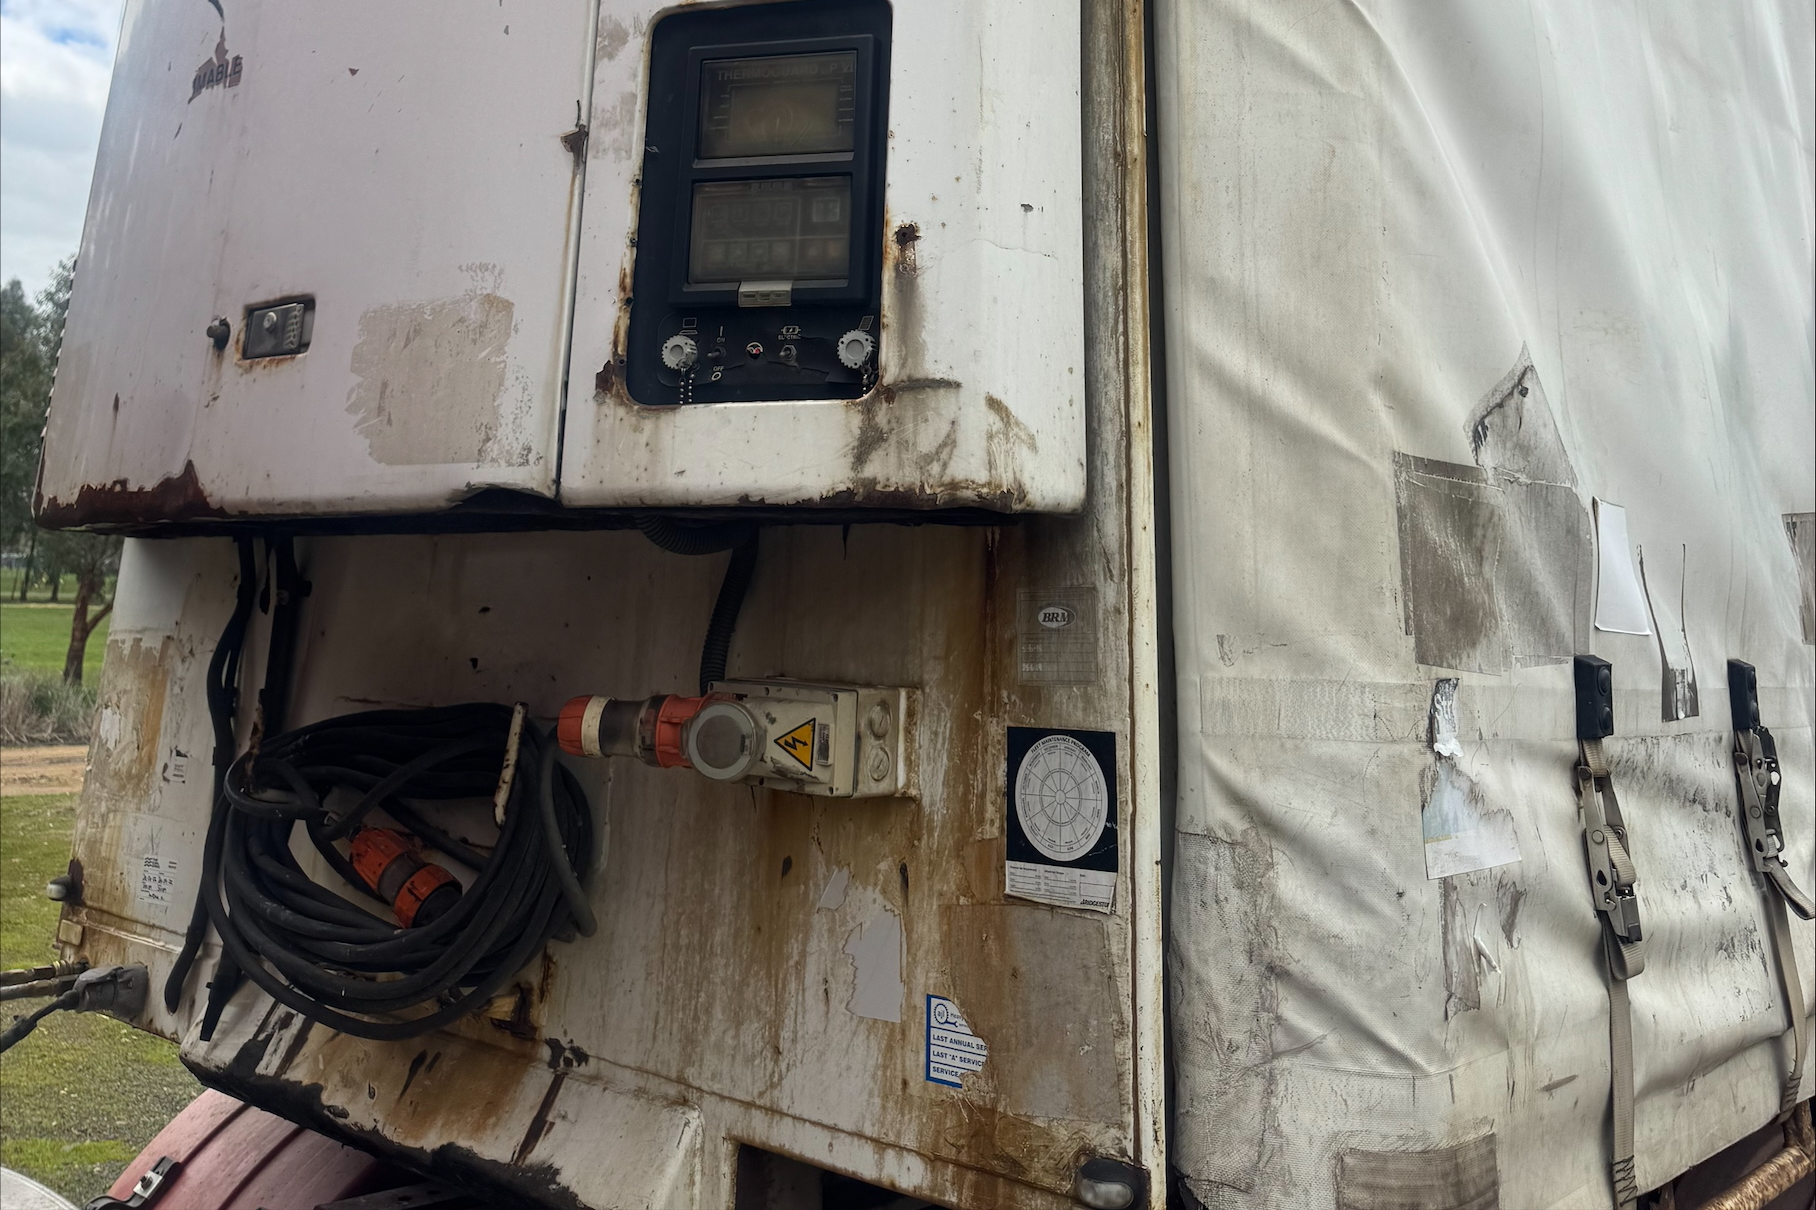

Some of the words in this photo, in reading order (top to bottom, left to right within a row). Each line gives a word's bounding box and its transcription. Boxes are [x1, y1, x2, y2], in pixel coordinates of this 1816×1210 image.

[717, 64, 819, 81] THERMOGUARD
[932, 1034, 948, 1043] LAST
[949, 1038, 975, 1049] ANNUAL
[932, 1050, 948, 1059] LAST
[932, 1066, 959, 1077] SERVICE
